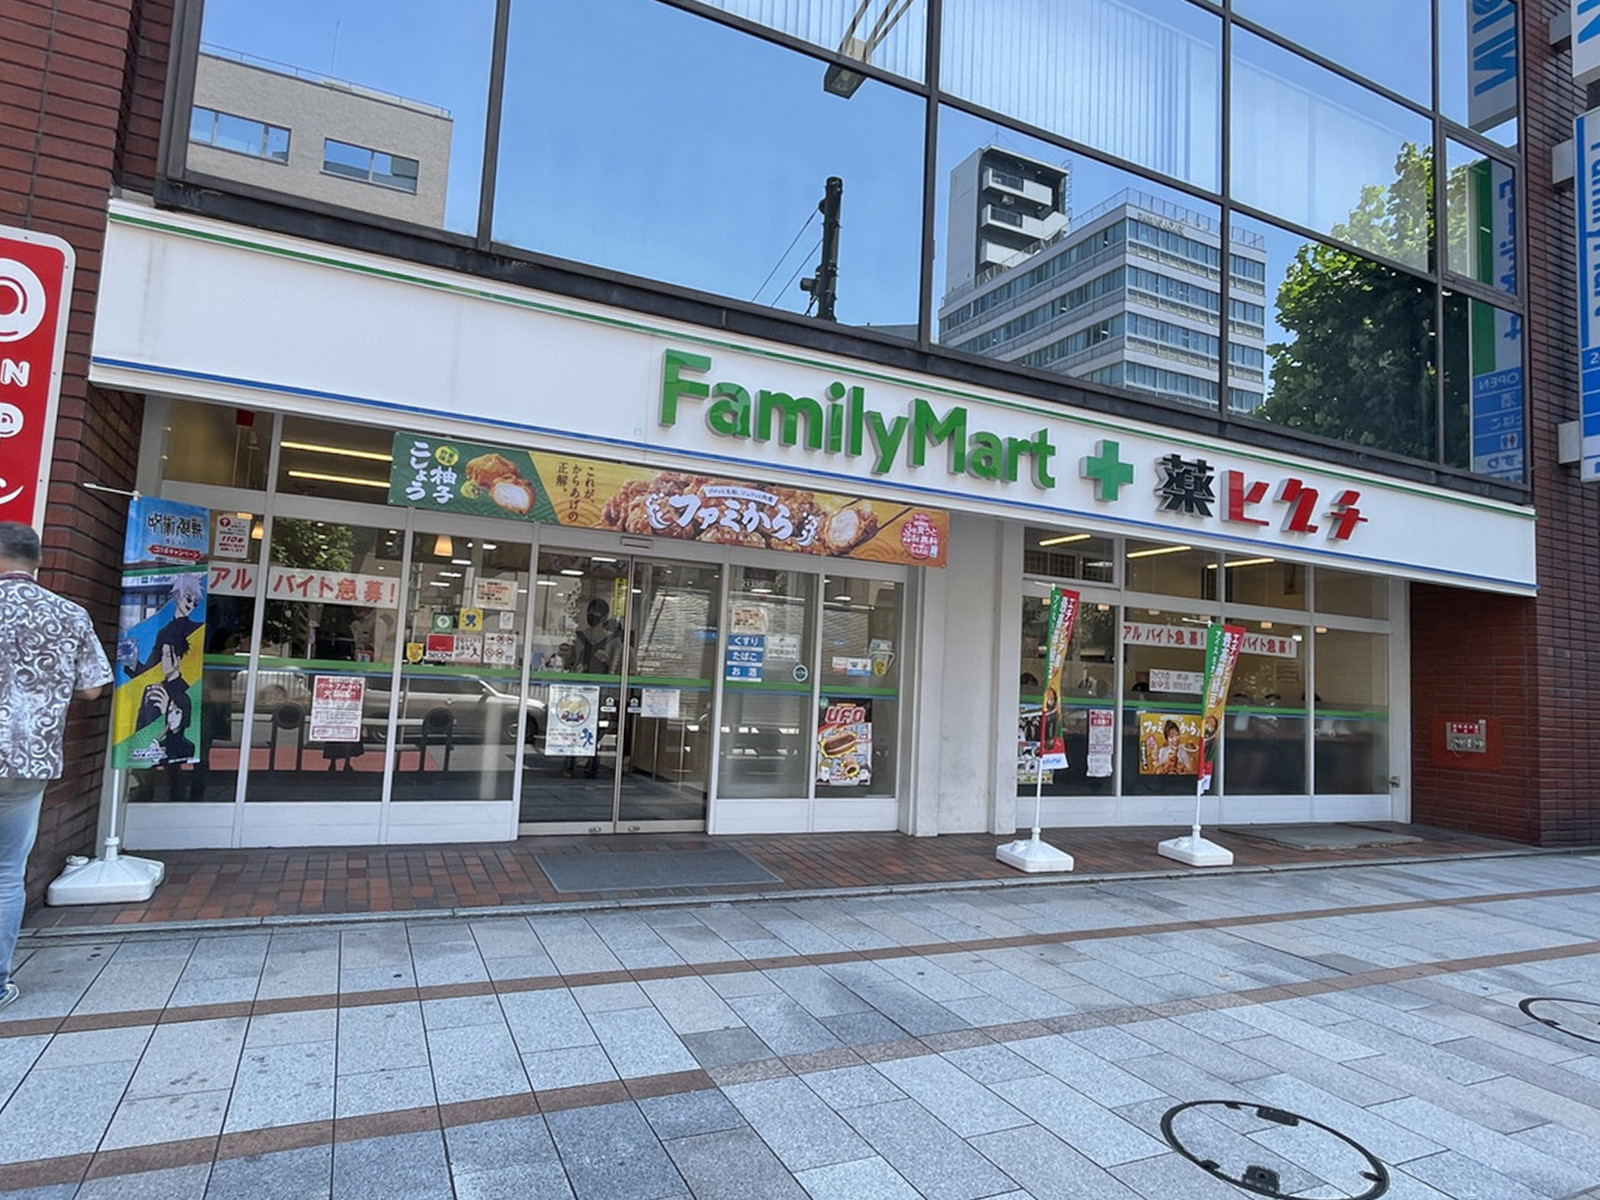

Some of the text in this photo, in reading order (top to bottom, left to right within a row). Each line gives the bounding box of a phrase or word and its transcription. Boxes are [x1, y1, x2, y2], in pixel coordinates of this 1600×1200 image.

[659, 349, 1056, 490] FamilyMart
[405, 441, 432, 501] こしょう
[430, 465, 457, 504] 柚子
[556, 462, 569, 492] 正解。
[583, 466, 595, 502] これが、
[567, 464, 582, 521] からあげの
[668, 494, 794, 540] ファミから
[210, 566, 252, 591] アル
[733, 651, 757, 661] たばこ
[734, 636, 759, 646] くすり
[825, 705, 866, 724] UFO
